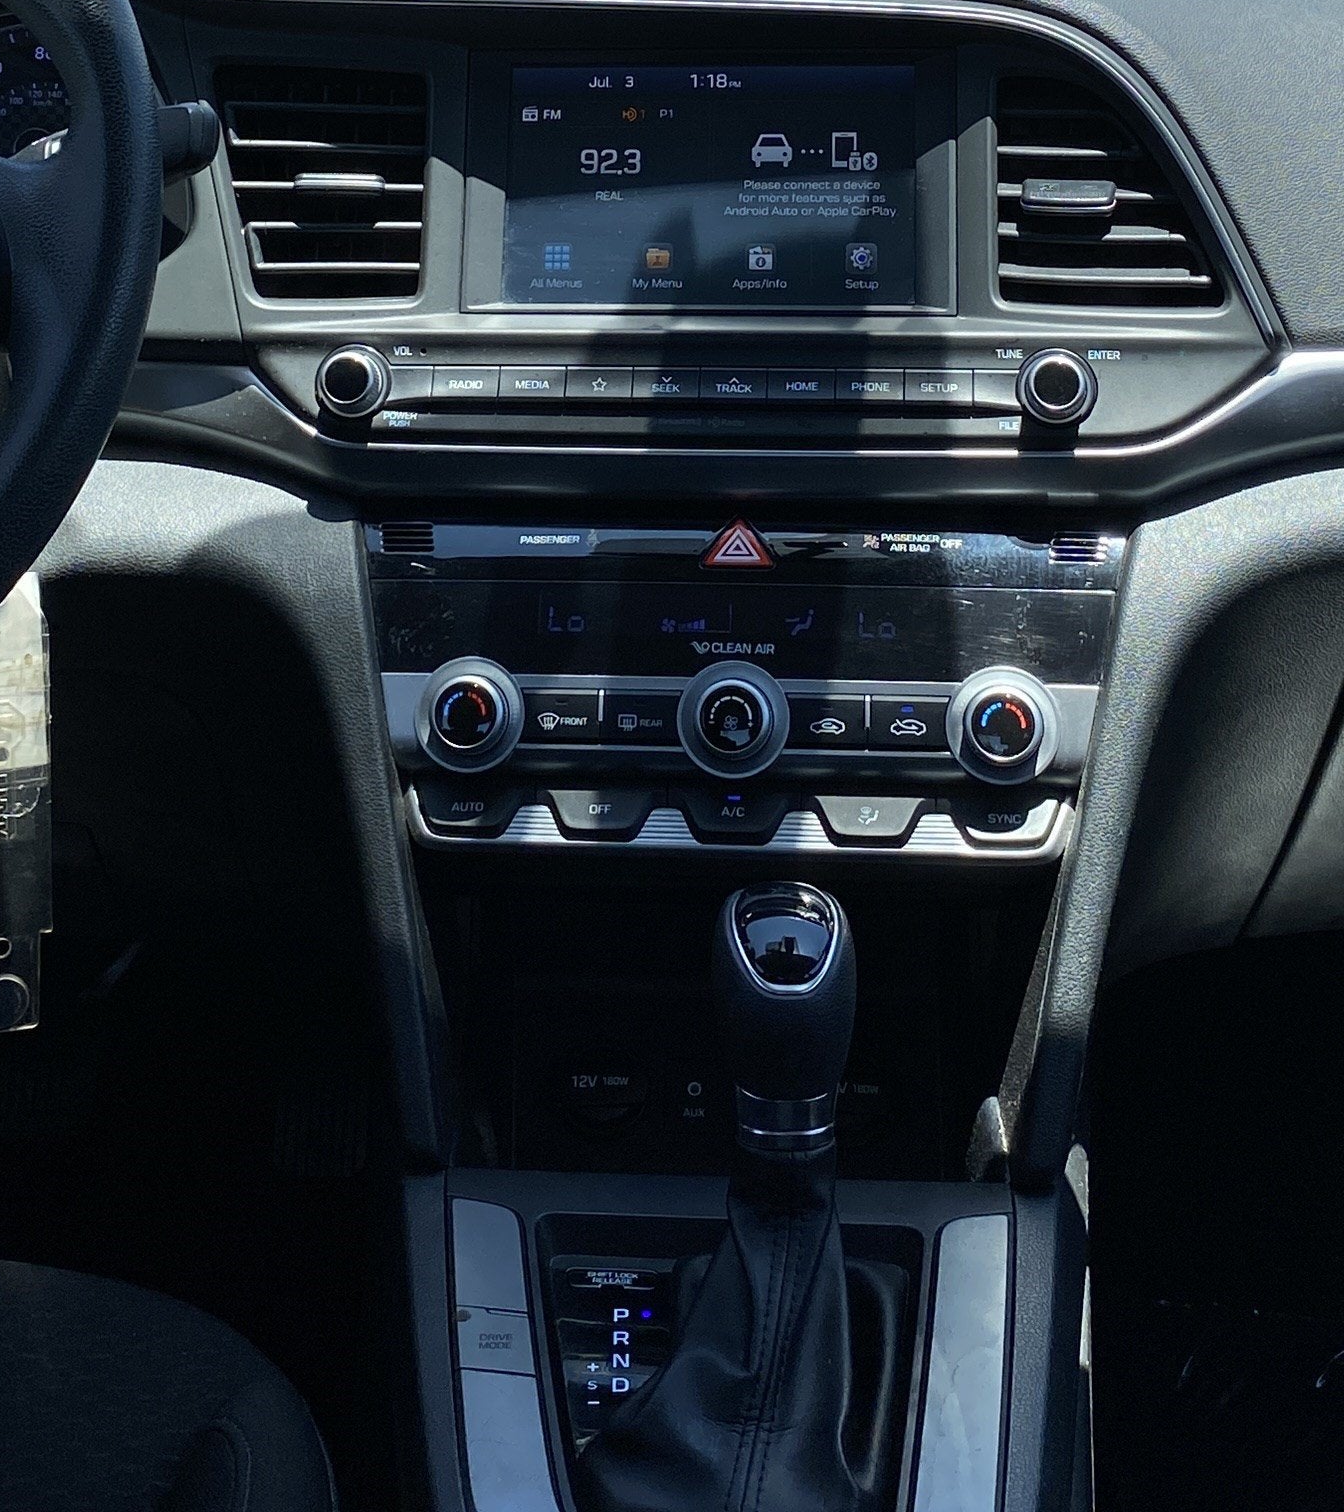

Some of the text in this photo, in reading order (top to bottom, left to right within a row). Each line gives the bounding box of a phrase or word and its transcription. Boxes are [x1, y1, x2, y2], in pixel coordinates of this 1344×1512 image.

[625, 76, 634, 88] 3
[690, 74, 728, 88] 1:18
[9, 97, 24, 105] 100
[543, 110, 562, 120] FM
[659, 109, 674, 118] P1
[580, 149, 641, 175] 92.3
[743, 180, 781, 190] Please
[783, 181, 831, 190] connect
[844, 180, 881, 190] device
[595, 191, 624, 201] REAL
[739, 193, 886, 204] for more features such as
[724, 206, 896, 219] Android Auto or Apple CarPlay
[530, 279, 582, 288] All Menus
[632, 279, 683, 291] My Menu
[733, 279, 787, 291] Apps/Info
[845, 279, 879, 291] Setup
[394, 346, 412, 356] VOL
[996, 349, 1023, 359] TUNE
[1088, 350, 1121, 360] ENTER
[448, 380, 483, 389] RADIO
[515, 380, 550, 389] MEDIA
[651, 384, 680, 393] SEEK
[716, 384, 752, 393] TRACK
[786, 382, 819, 391] HOME
[851, 382, 890, 391] PHONE
[920, 383, 958, 393] SETUP
[383, 410, 417, 420] POWER
[999, 422, 1020, 431] FILE
[519, 534, 580, 545] PASSENGER
[880, 533, 940, 543] PASSENGER
[940, 538, 963, 548] OFF
[889, 543, 931, 553] AIR BAG
[711, 641, 775, 655] CLEAN AIR
[560, 717, 588, 727] FRONT
[640, 718, 663, 727] REAR
[451, 801, 484, 813] AUTO
[589, 803, 612, 814] OFF
[721, 805, 746, 818] A/C
[987, 813, 1021, 825] SYNC
[571, 1075, 629, 1088] 12V 180W
[683, 1108, 705, 1118] AUX
[613, 1308, 630, 1323] P
[479, 1333, 513, 1341] DRIVE
[612, 1331, 630, 1346] R
[479, 1341, 513, 1350] MODE
[612, 1353, 630, 1368] N
[587, 1380, 598, 1390] S
[612, 1377, 630, 1392] D
